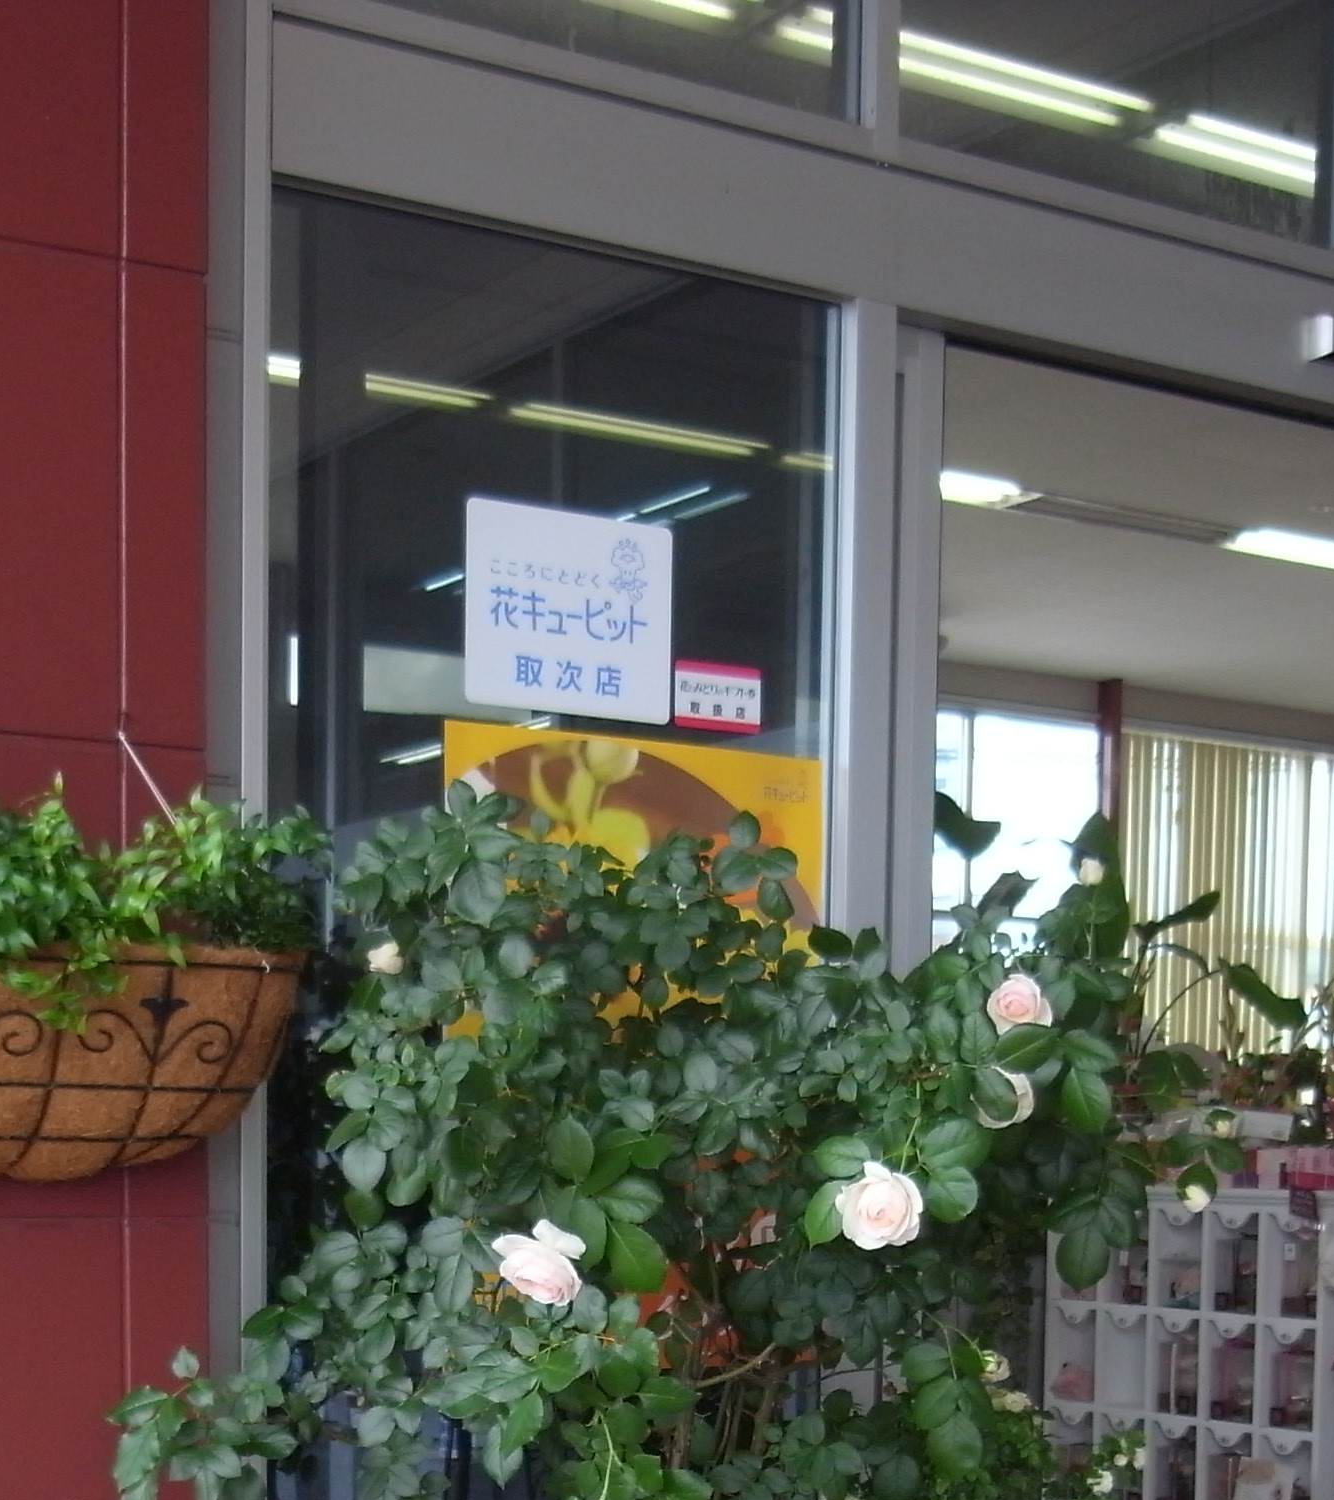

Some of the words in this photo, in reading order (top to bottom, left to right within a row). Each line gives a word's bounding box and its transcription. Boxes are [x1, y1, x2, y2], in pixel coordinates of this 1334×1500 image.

[489, 558, 601, 590] こころにとどく
[489, 585, 648, 645] 花キューピット
[515, 655, 622, 697] 取次店
